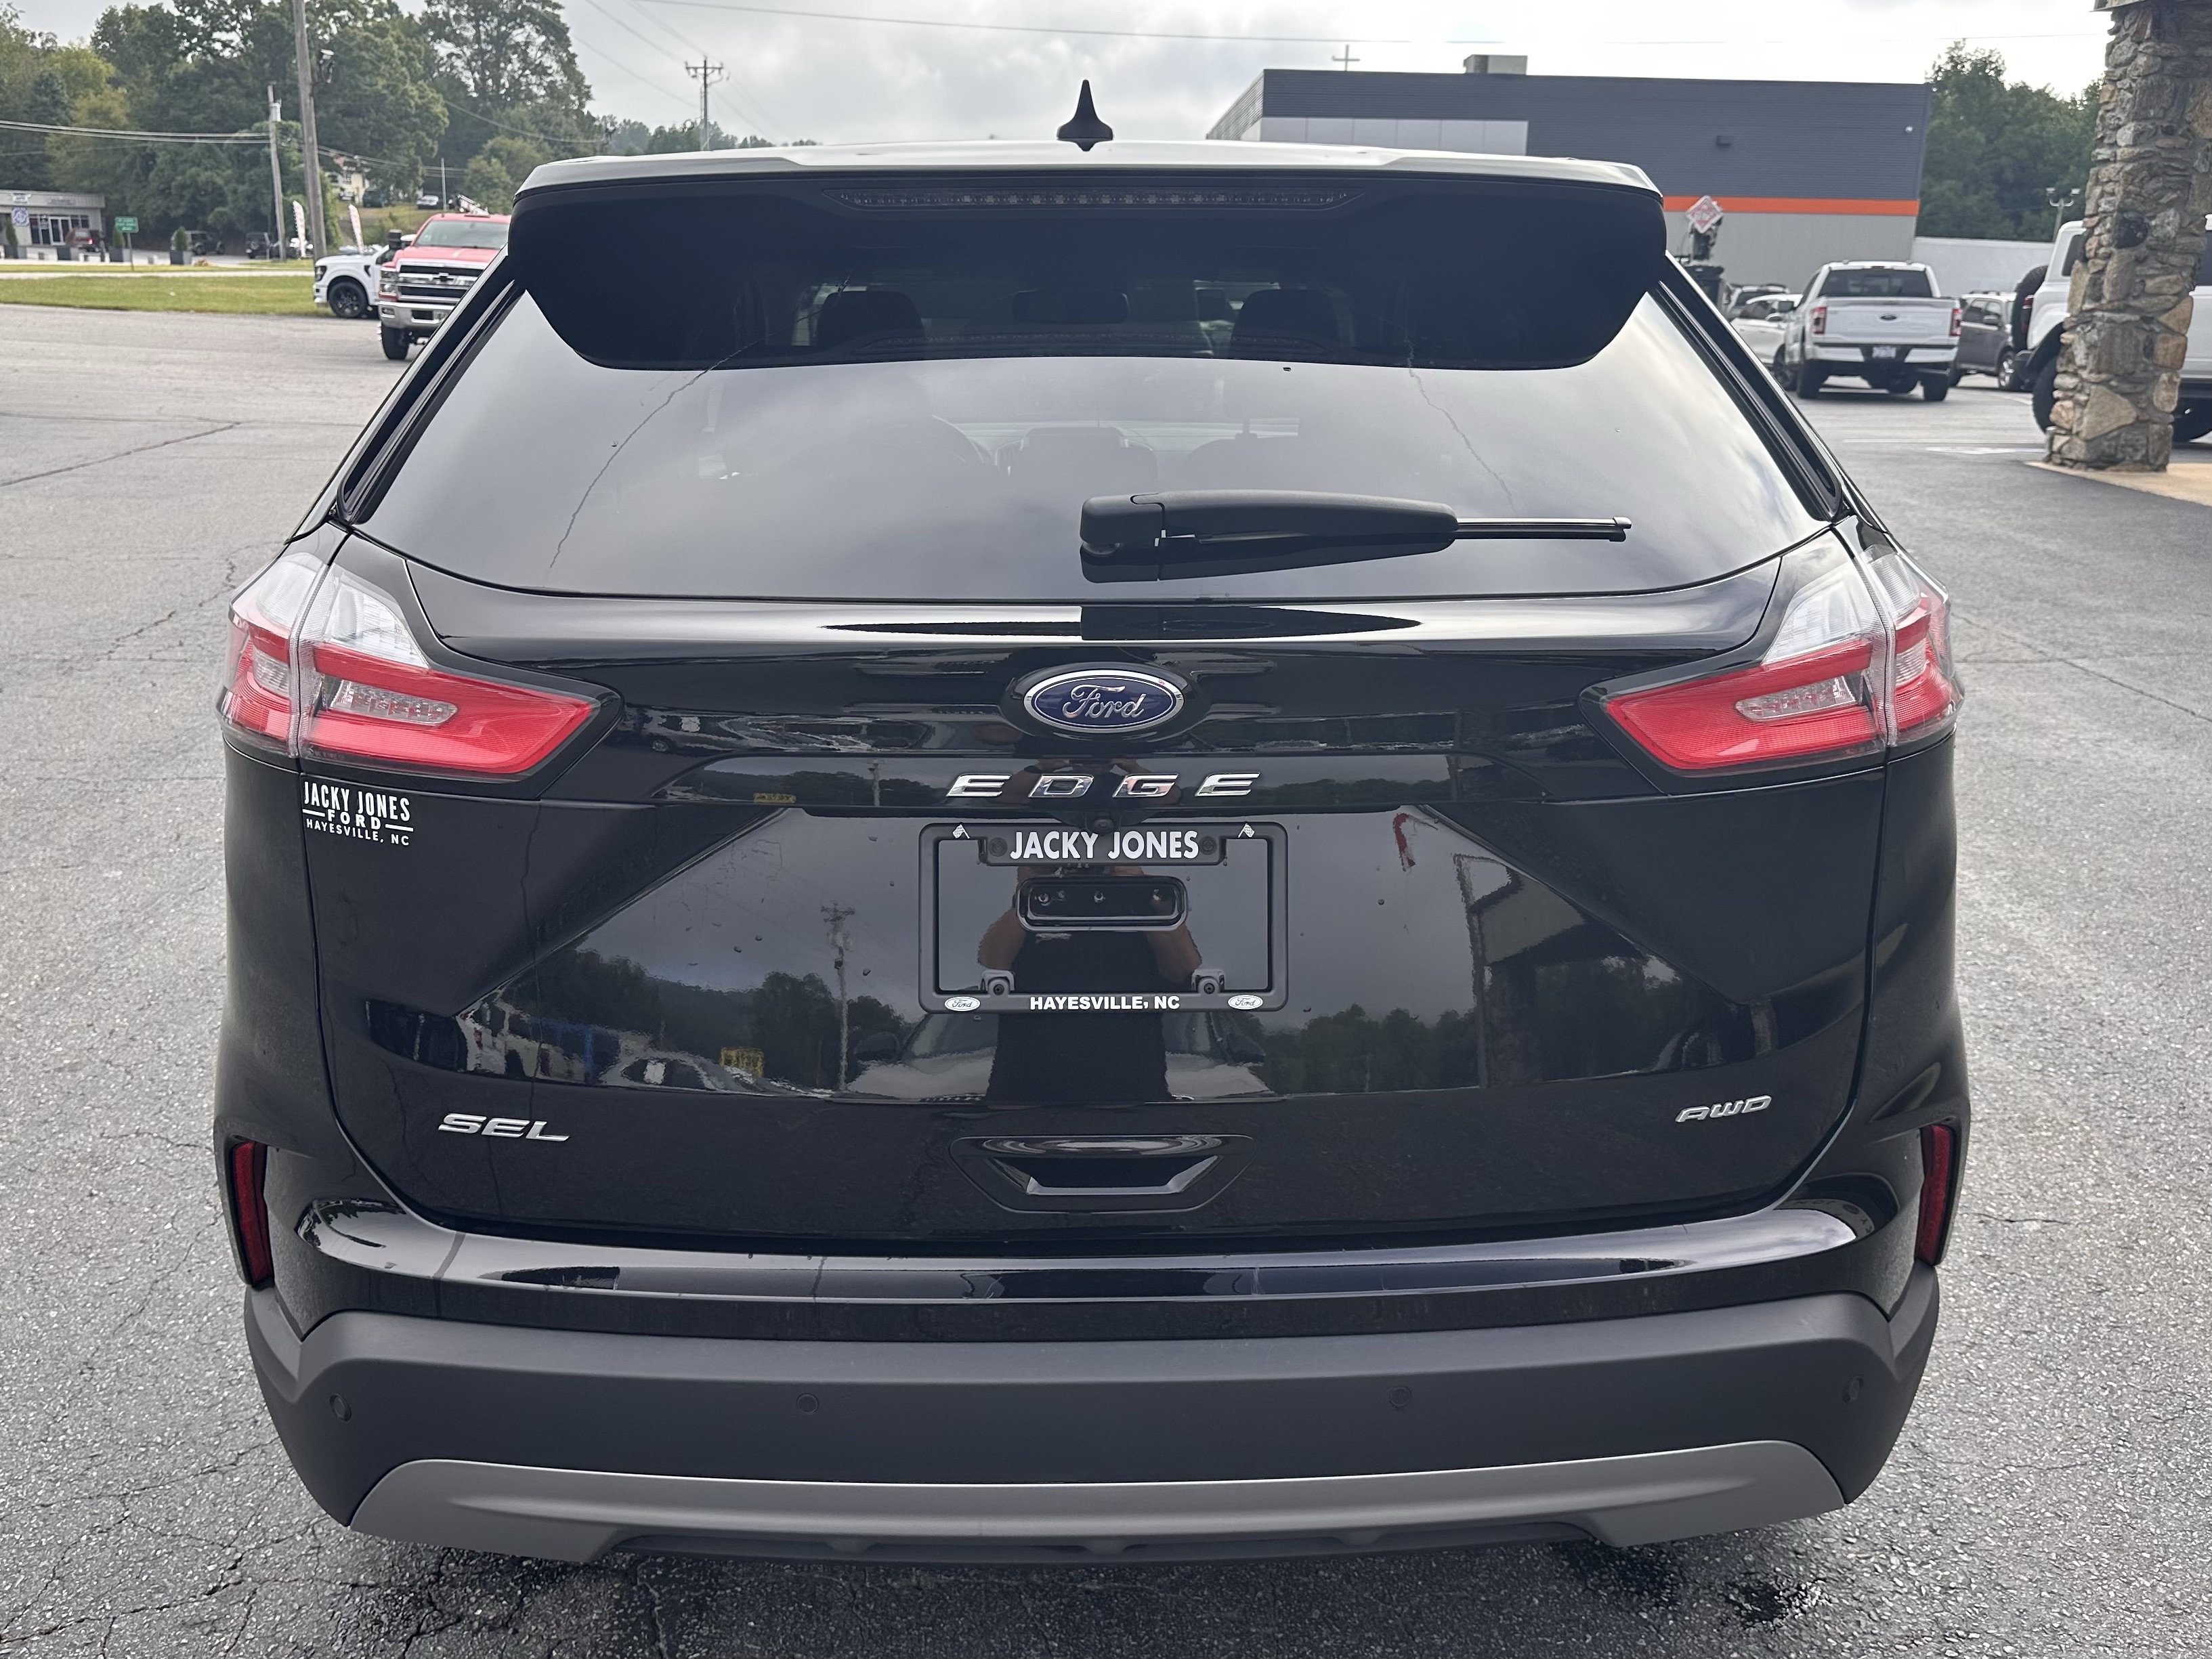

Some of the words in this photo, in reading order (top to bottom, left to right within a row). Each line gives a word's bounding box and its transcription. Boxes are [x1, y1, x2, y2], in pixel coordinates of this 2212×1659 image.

[1062, 684, 1147, 718] Ford
[945, 772, 1260, 798] EDGE
[304, 781, 350, 812] JACKY
[357, 791, 410, 821] JONES
[306, 818, 384, 843] HAYESVILLE,
[391, 834, 410, 846] NC
[327, 809, 381, 830] FORD
[1010, 831, 1099, 859] JACKY
[1107, 830, 1199, 859] JONES
[1029, 995, 1149, 1010] HAYESVILLE,
[1153, 995, 1180, 1010] NC
[1675, 1094, 1772, 1123] AWD
[438, 1113, 570, 1142] SEL
